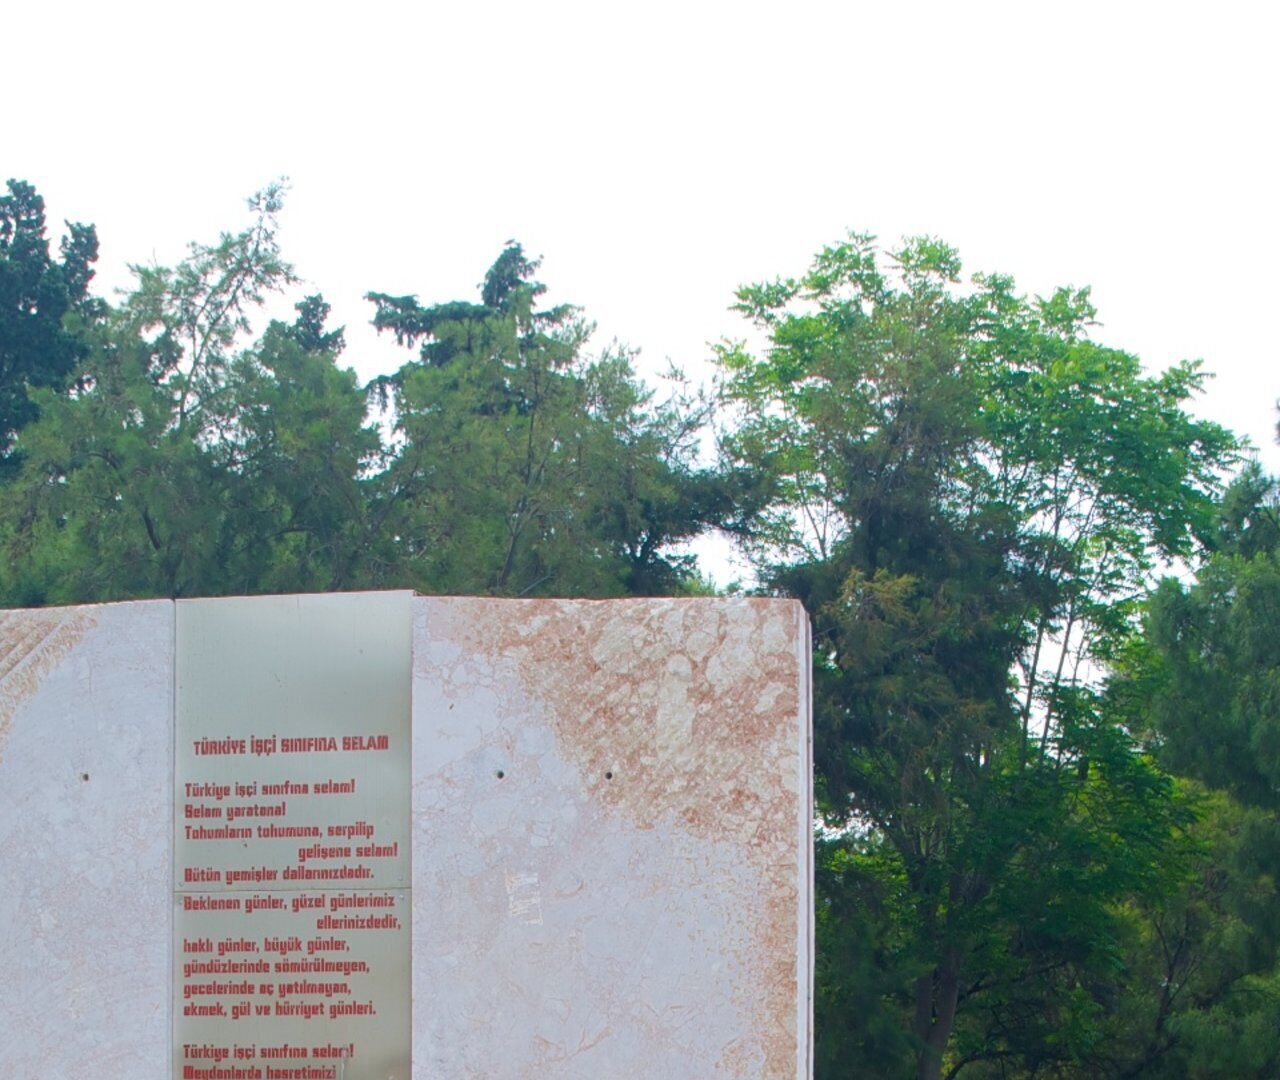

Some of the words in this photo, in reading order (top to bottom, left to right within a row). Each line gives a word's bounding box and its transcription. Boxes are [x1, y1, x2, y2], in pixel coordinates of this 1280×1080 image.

[194, 736, 246, 755] TÜRKİYE
[251, 735, 276, 756] İŞÇİ
[281, 738, 337, 753] SINIFINA
[343, 735, 389, 751] SELAM
[185, 783, 230, 800] Türkiye
[236, 782, 257, 796] işçi
[262, 781, 308, 795] sınıfına
[314, 779, 355, 794] selam!
[185, 804, 221, 818] Selam
[227, 802, 286, 821] yaratana!
[185, 825, 252, 840] Tohumların
[258, 824, 322, 838] tohumuna,
[328, 822, 374, 839] serpilip
[298, 844, 351, 862] gelişene
[356, 843, 398, 857] selam!
[184, 868, 220, 882] Bütün
[226, 867, 277, 885] yemişler
[283, 865, 374, 880] dallarınızdadır.
[184, 895, 240, 911] Beklenen
[245, 895, 287, 913] günler,
[292, 894, 325, 912] güzel
[330, 892, 395, 911] günlerimiz
[317, 915, 401, 930] ellerinizdedir,
[184, 939, 212, 953] haklı
[218, 938, 259, 955] günler,
[265, 938, 301, 955] büyük
[307, 937, 349, 954] günler,
[184, 960, 270, 977] gündüzlerinde
[275, 958, 370, 975] sömürülmeyen,
[184, 981, 254, 998] gecelerinde
[260, 983, 273, 996] aç
[279, 980, 351, 997] yatılmayan,
[184, 1003, 227, 1017] ekmek,
[232, 1002, 251, 1019] gül
[256, 1004, 270, 1015] ve
[276, 1001, 324, 1019] hürriyet
[330, 1001, 376, 1019] günleri.
[183, 1045, 229, 1062] Türkiye
[234, 1044, 255, 1059] işçi
[260, 1044, 307, 1058] sınıfına
